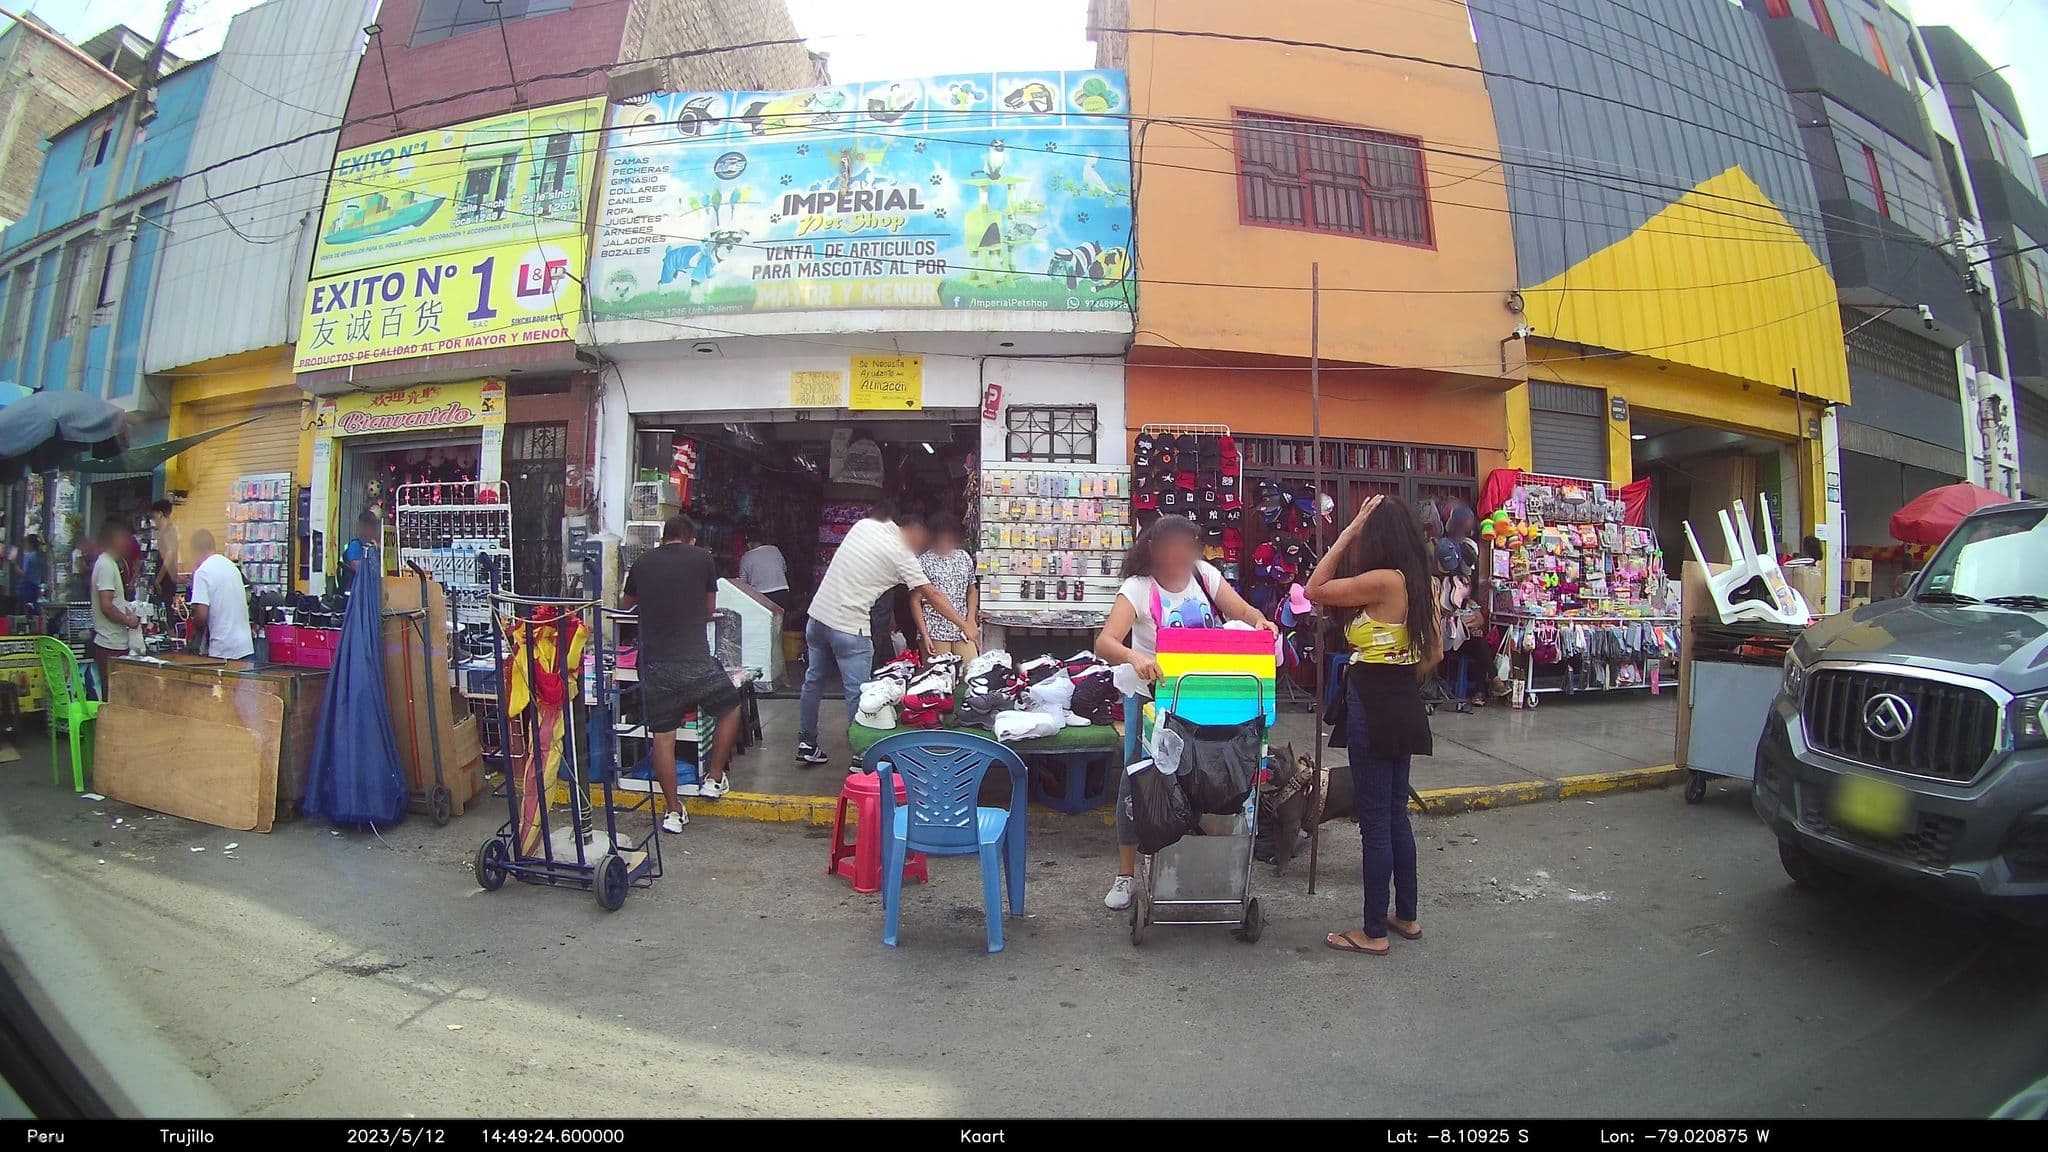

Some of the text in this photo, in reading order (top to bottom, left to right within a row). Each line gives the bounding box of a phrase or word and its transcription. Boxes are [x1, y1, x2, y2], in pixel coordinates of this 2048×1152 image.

[338, 148, 395, 177] EXITO
[614, 157, 649, 166] CAMAS
[612, 165, 670, 175] PECHERAS
[611, 176, 658, 185] GIMNASIO
[609, 185, 667, 195] COLLARES
[608, 196, 652, 205] CANILES
[783, 188, 925, 216] IMPERIAL
[606, 207, 634, 216] ROPA
[605, 215, 662, 225] JUGUETES
[799, 214, 905, 236] Pet Shop
[602, 236, 666, 247] JALADORES
[600, 247, 650, 257] BOZALES
[766, 240, 935, 261] VENTA DE ARTICULOS
[752, 259, 946, 280] PARA MASCOTAS AL POR
[311, 272, 405, 315] EXITO
[468, 256, 497, 321] 1
[759, 282, 937, 308] MAYOR Y MENOR
[310, 300, 443, 350] 友诚百货
[300, 328, 569, 367] PRODUCTOS DE CALIDAD AL POR MAYOR Y MENOR
[861, 380, 907, 391] Almacen
[339, 402, 475, 433] Bienvenido
